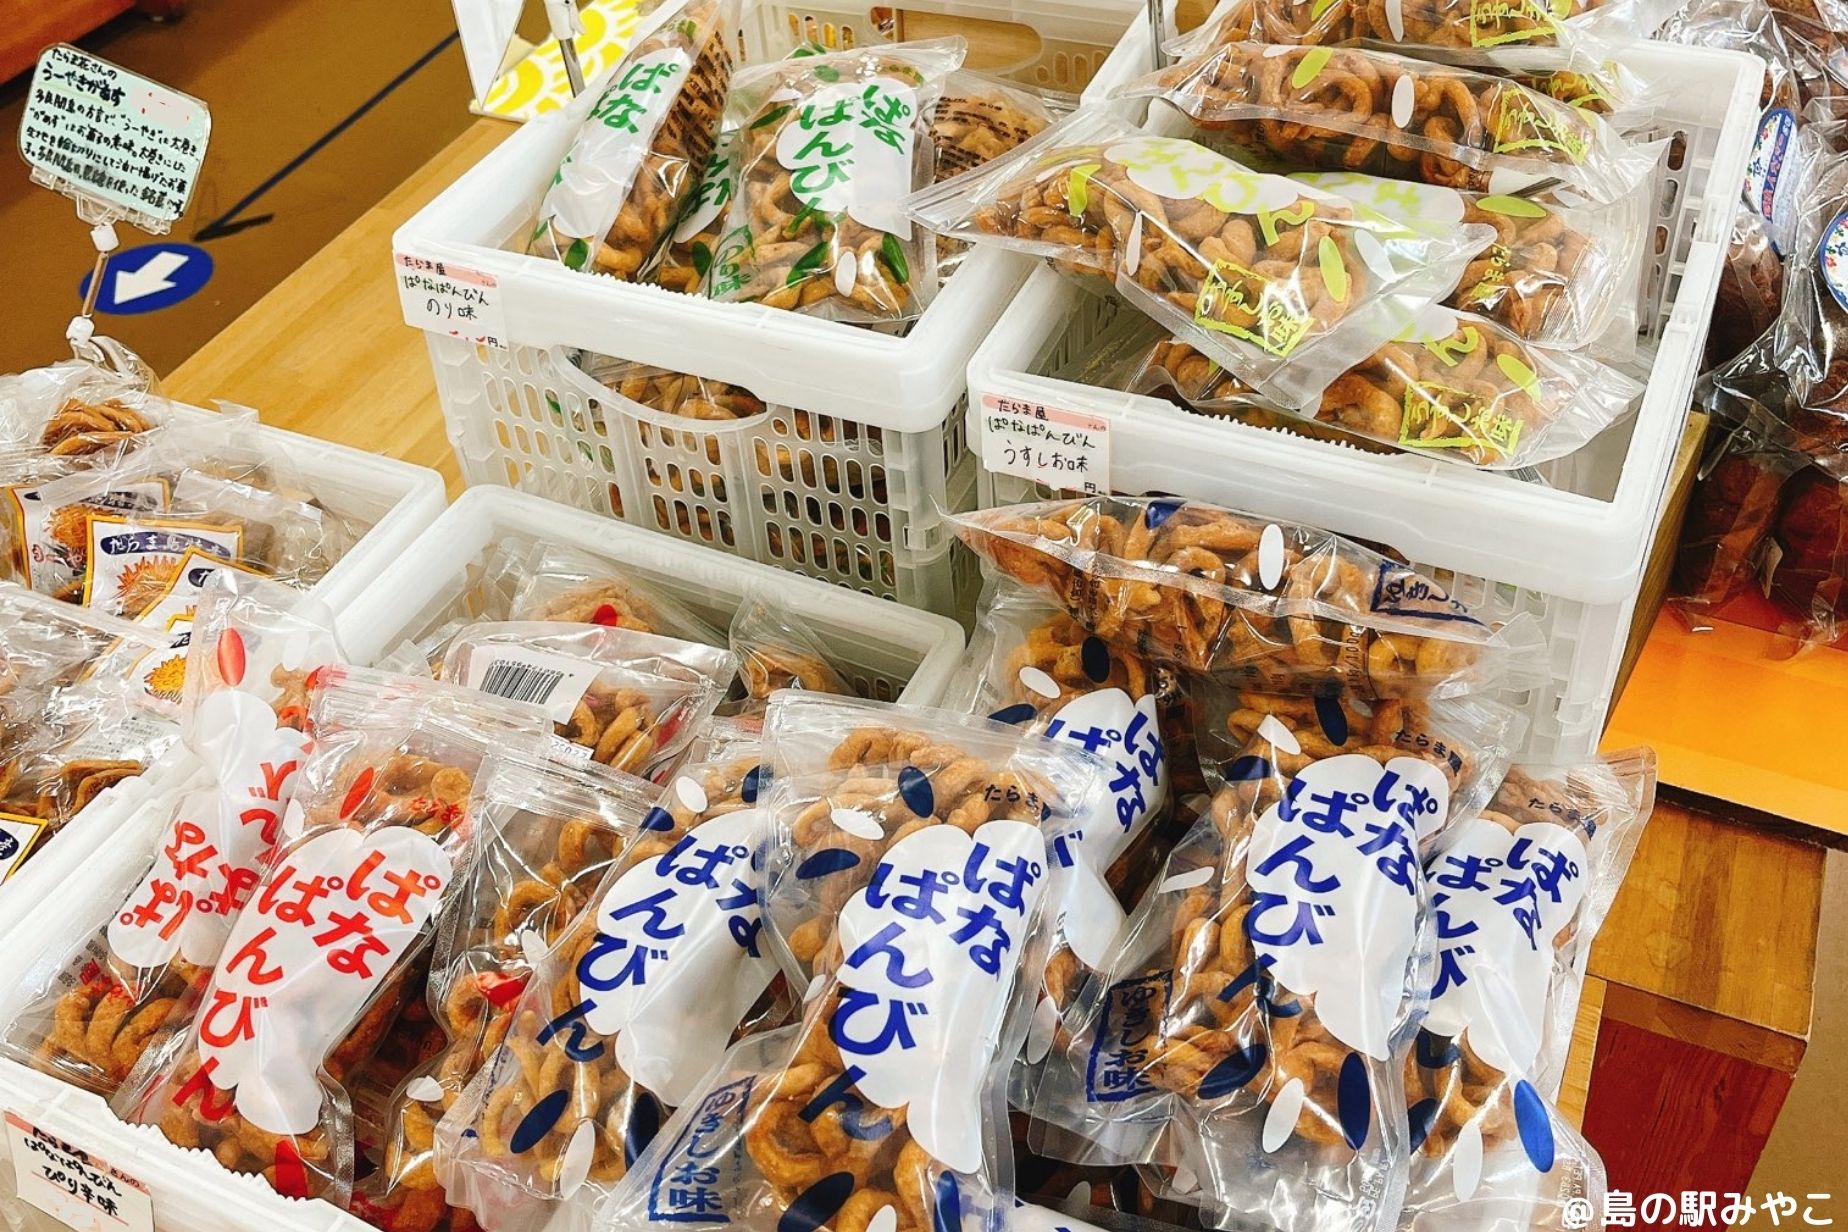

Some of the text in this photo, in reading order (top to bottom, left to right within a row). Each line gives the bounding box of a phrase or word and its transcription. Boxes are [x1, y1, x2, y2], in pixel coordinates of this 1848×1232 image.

[404, 256, 446, 276] たらま屋
[404, 275, 490, 306] ぱなぱんびん
[427, 298, 478, 320] のり味
[988, 416, 1096, 449] ぱなぱんびん
[998, 400, 1049, 421] たらま屋
[1004, 440, 1089, 473] うすしお味
[984, 783, 1040, 814] たらま
[312, 850, 441, 979] ぱな
[955, 843, 1042, 982] ぱな
[1219, 777, 1371, 1019] ぱんびん
[1494, 838, 1580, 950] ぱな
[536, 835, 750, 1063] ぱんびん
[172, 865, 345, 1122] ぱんびん
[800, 862, 961, 1142] ぱんびん
[24, 1137, 123, 1197] ぱなぱんびん
[42, 1165, 119, 1217] ぴり辛味
